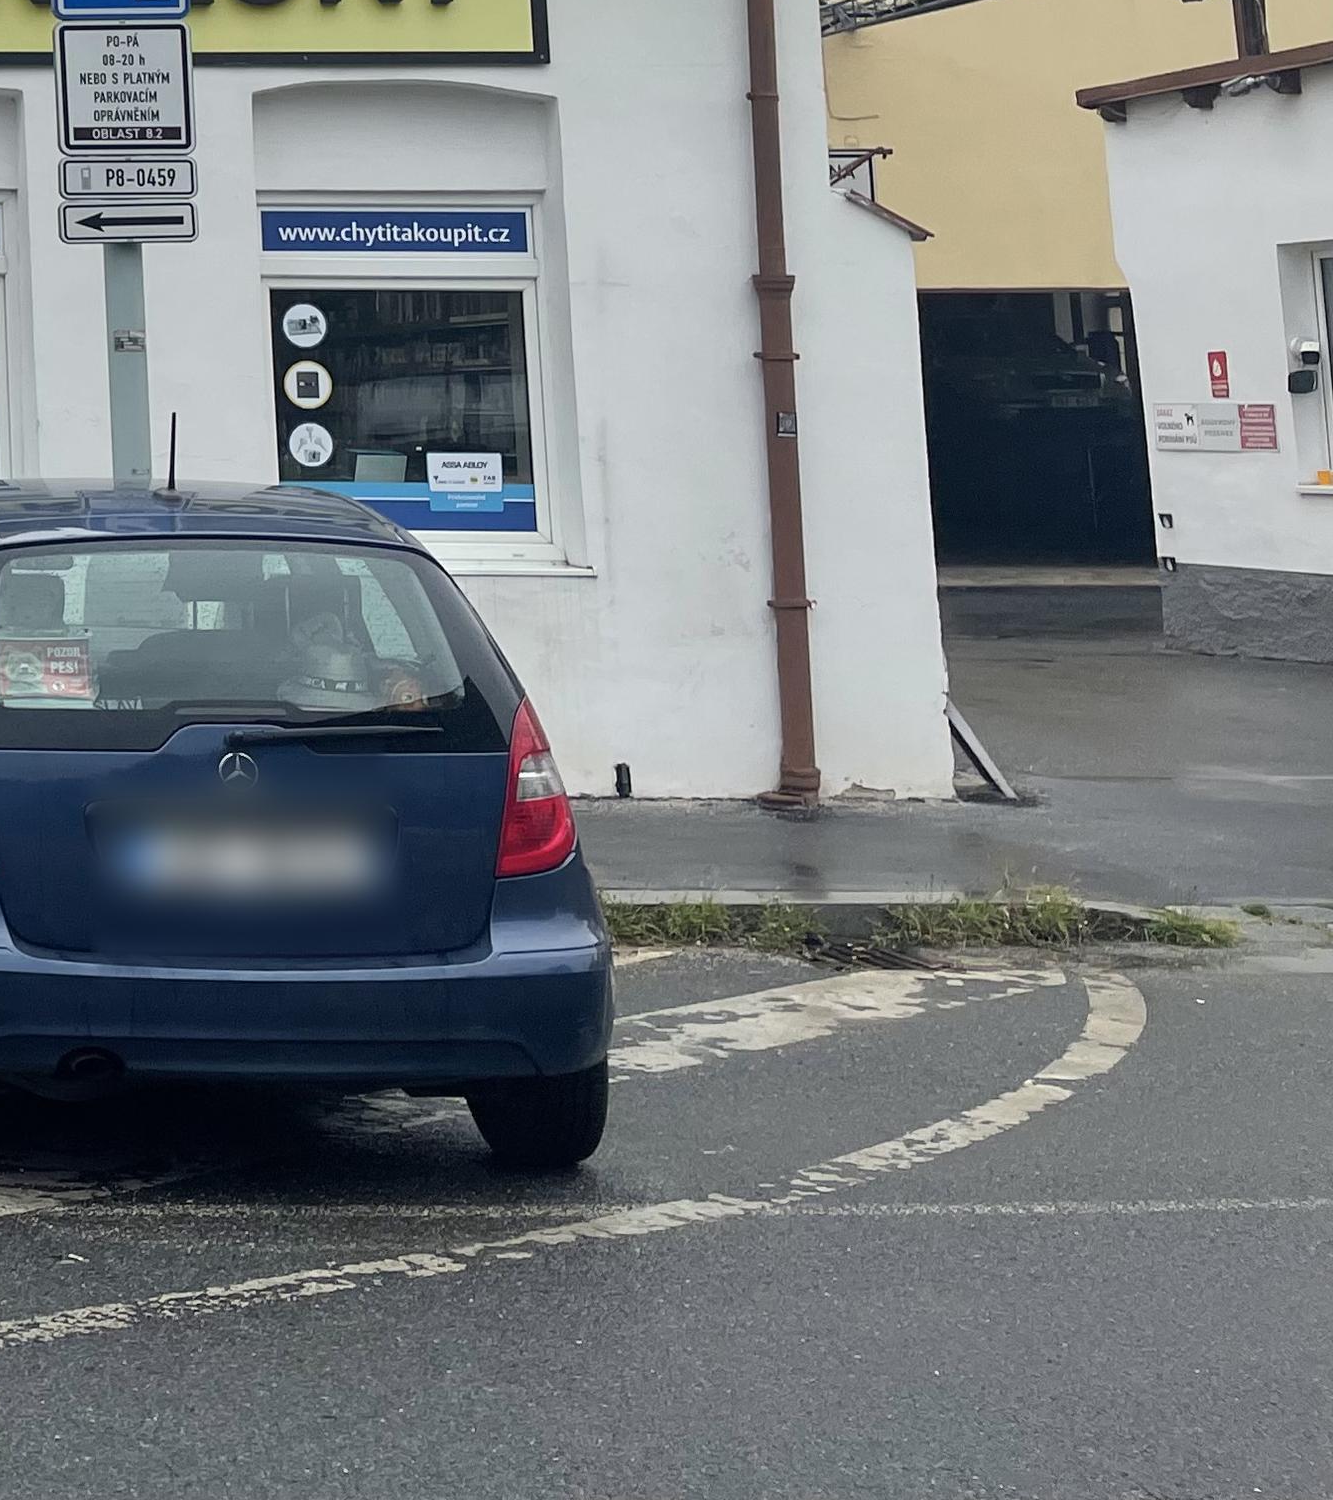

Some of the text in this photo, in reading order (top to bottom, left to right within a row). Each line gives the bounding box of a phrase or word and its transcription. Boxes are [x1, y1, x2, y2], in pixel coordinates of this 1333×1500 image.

[106, 32, 140, 48] PO-PÁ
[102, 53, 146, 66] 08-20 h
[79, 69, 171, 85] NEBO S PLATNÝM
[93, 88, 158, 103] PARKOVACÍM
[93, 106, 160, 122] OPRÁVNĚNÍM
[92, 127, 140, 140] OBLAST
[105, 168, 177, 188] P8-0459
[277, 221, 511, 247] www.chytitakoupit.cz
